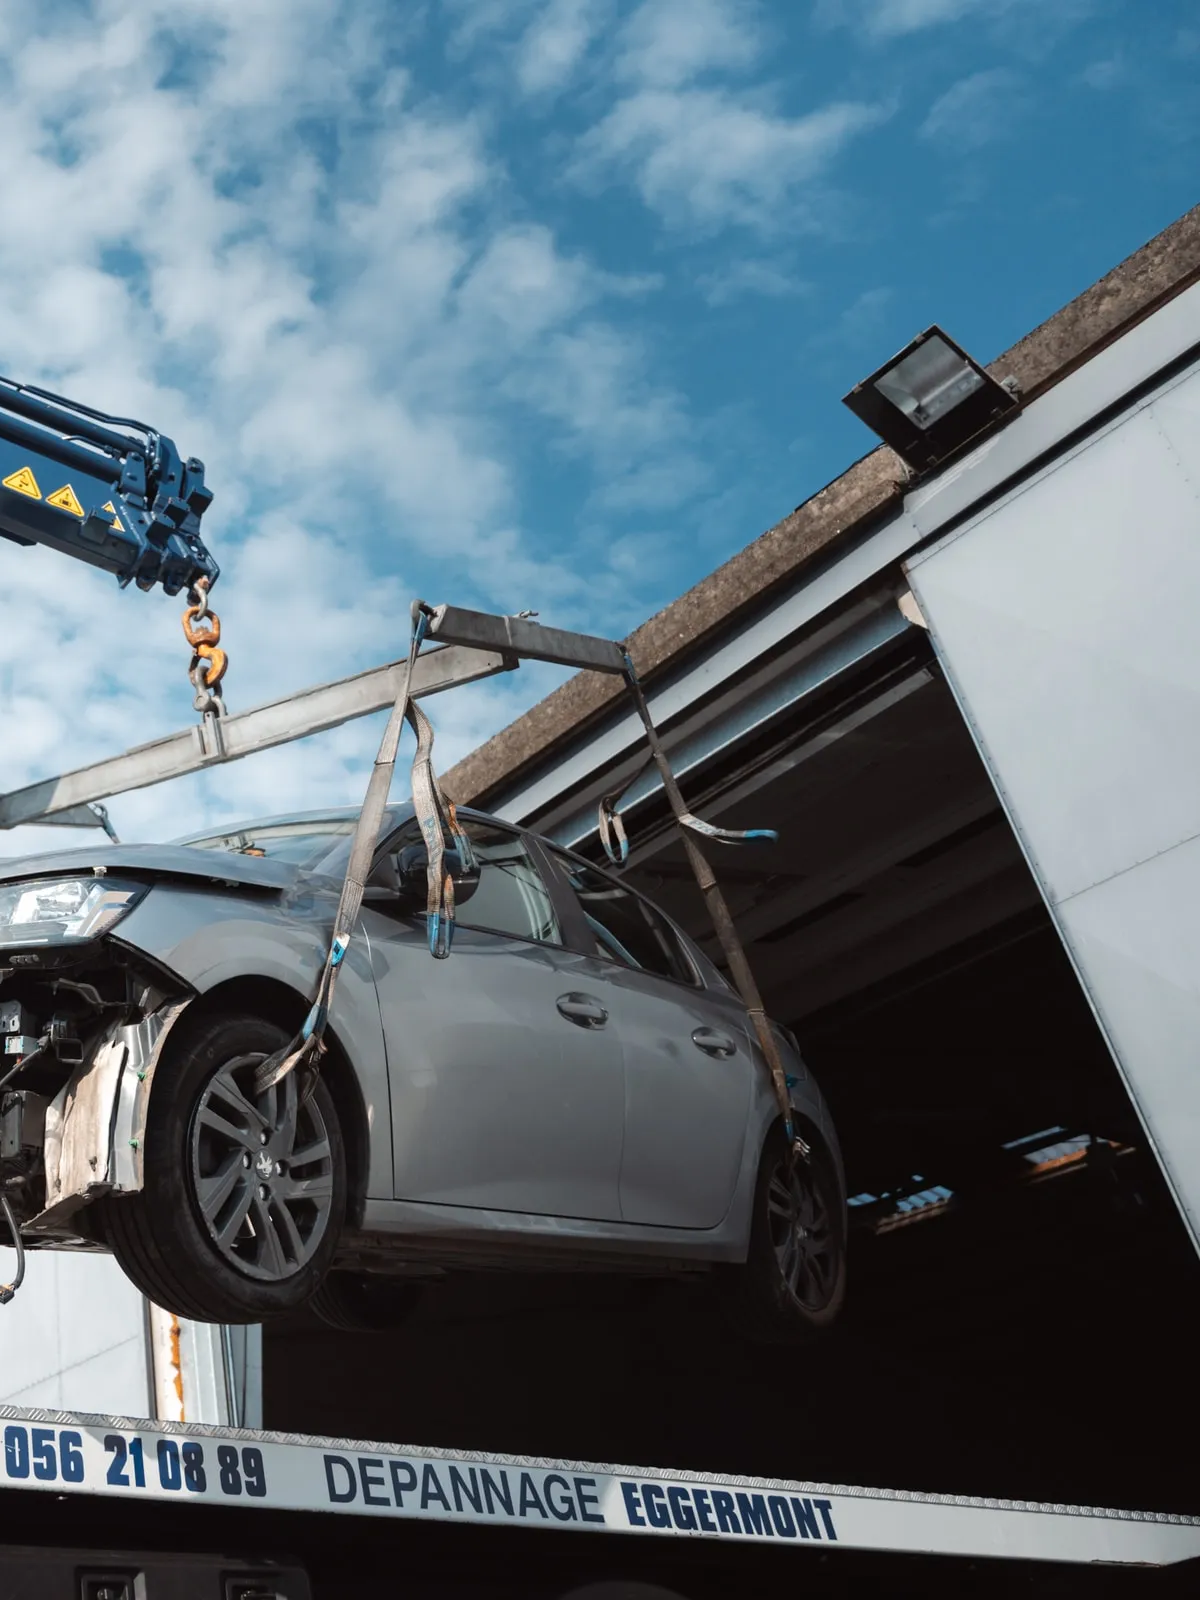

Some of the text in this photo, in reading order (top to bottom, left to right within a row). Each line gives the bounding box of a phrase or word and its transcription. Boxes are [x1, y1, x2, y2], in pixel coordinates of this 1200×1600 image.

[4, 1425, 838, 1541] 056 21 08 89 DEPANNAGE EGGERMONT
